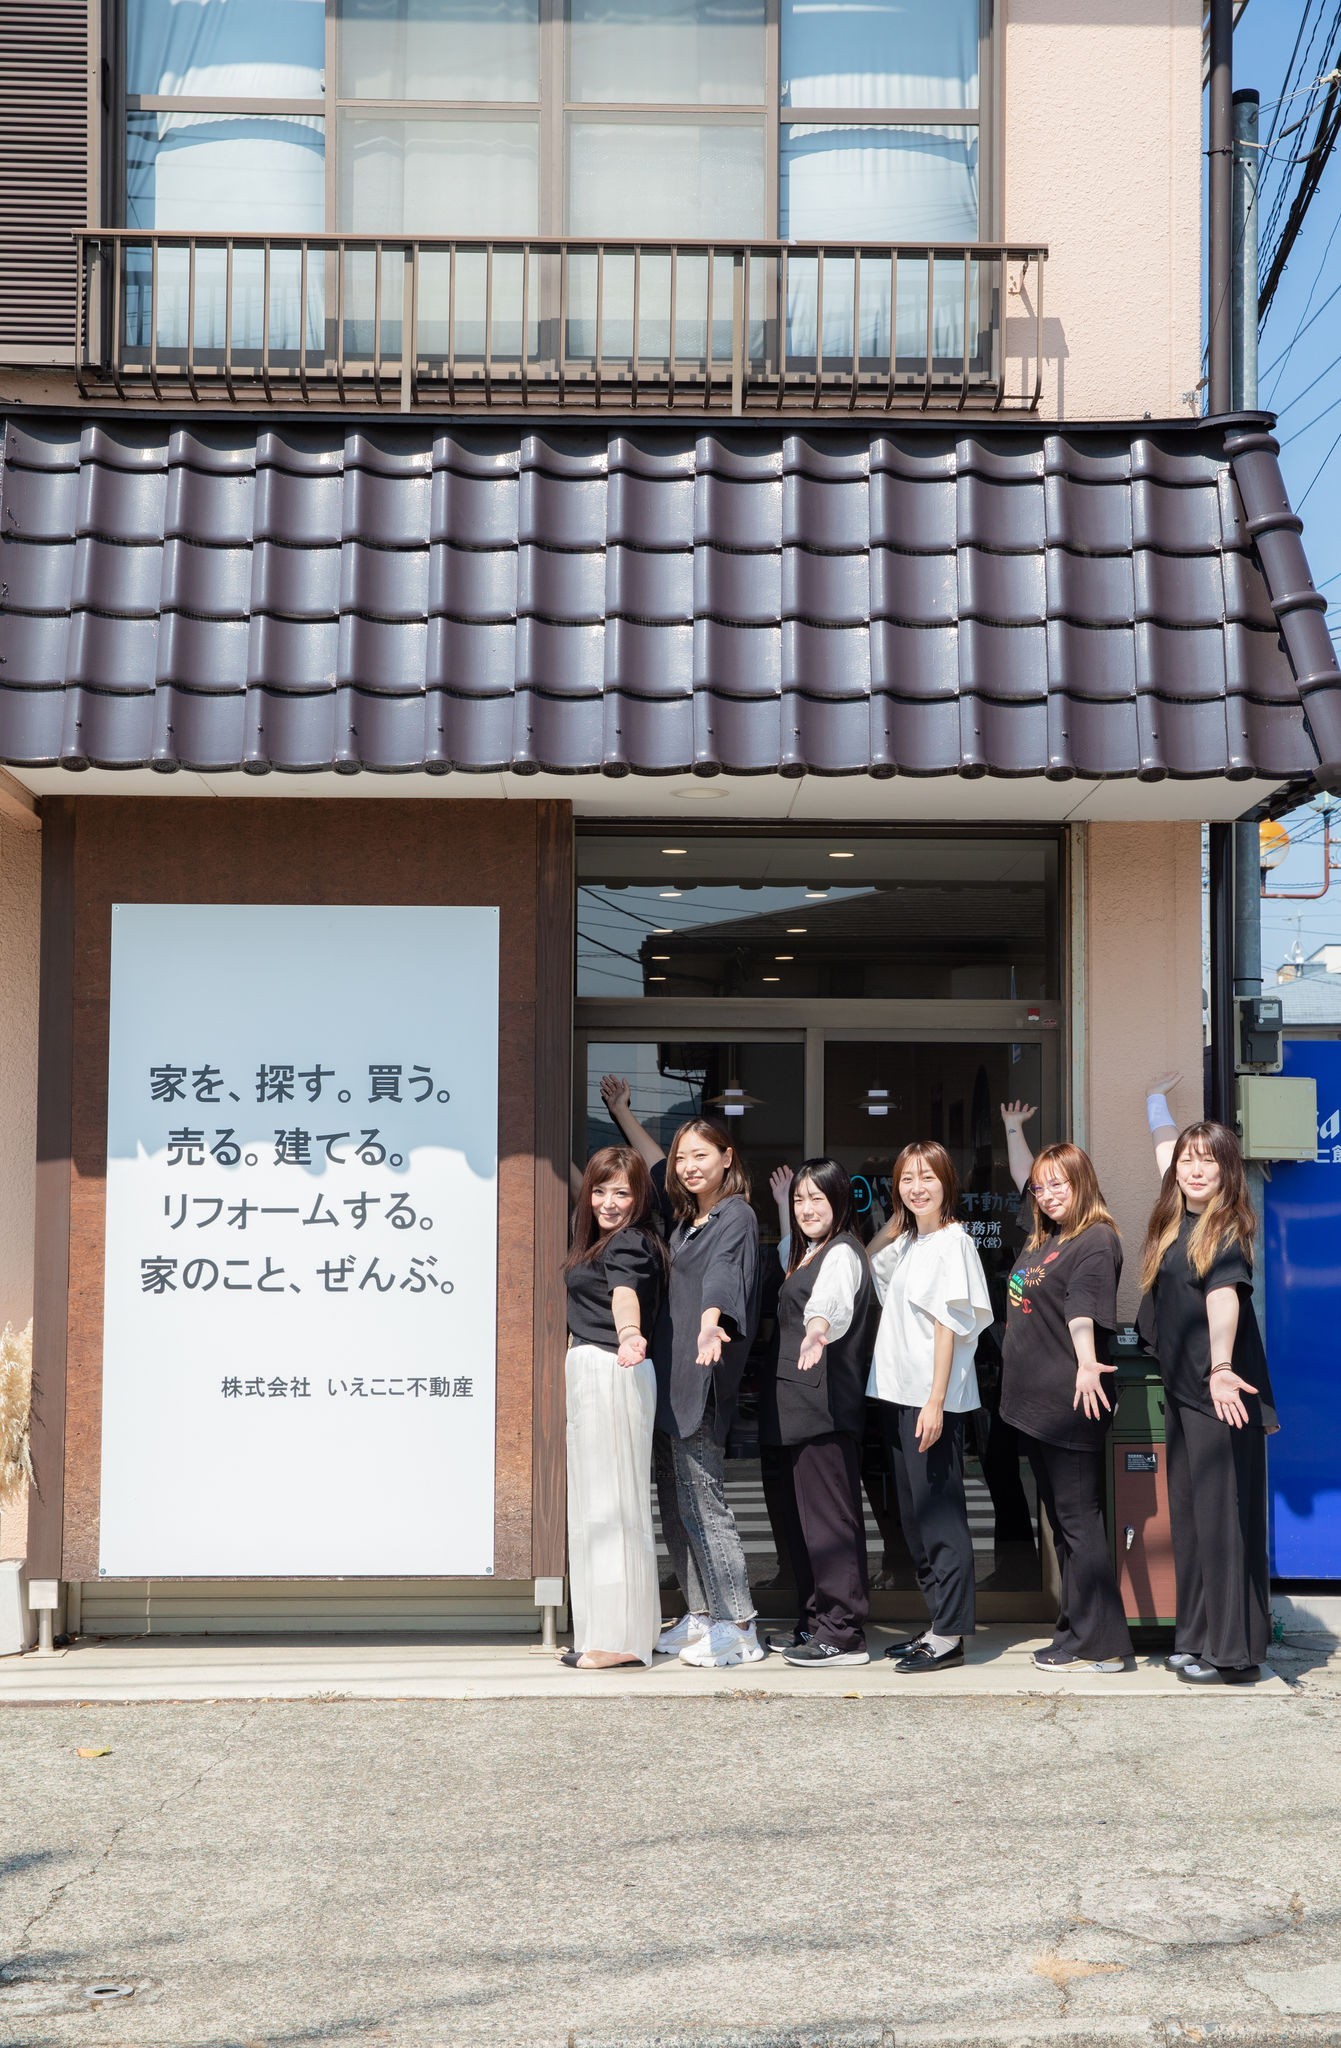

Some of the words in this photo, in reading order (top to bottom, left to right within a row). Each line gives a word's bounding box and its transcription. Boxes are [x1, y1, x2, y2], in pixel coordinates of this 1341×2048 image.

[149, 1063, 451, 1104] 家を、探す。買う。
[167, 1127, 405, 1167] 売る。建てる。
[163, 1191, 434, 1231] リフォームする。
[140, 1254, 455, 1295] 家のこと、ぜんぶ。
[220, 1375, 312, 1399] 株式会社
[327, 1375, 474, 1398] いえここ不動産
